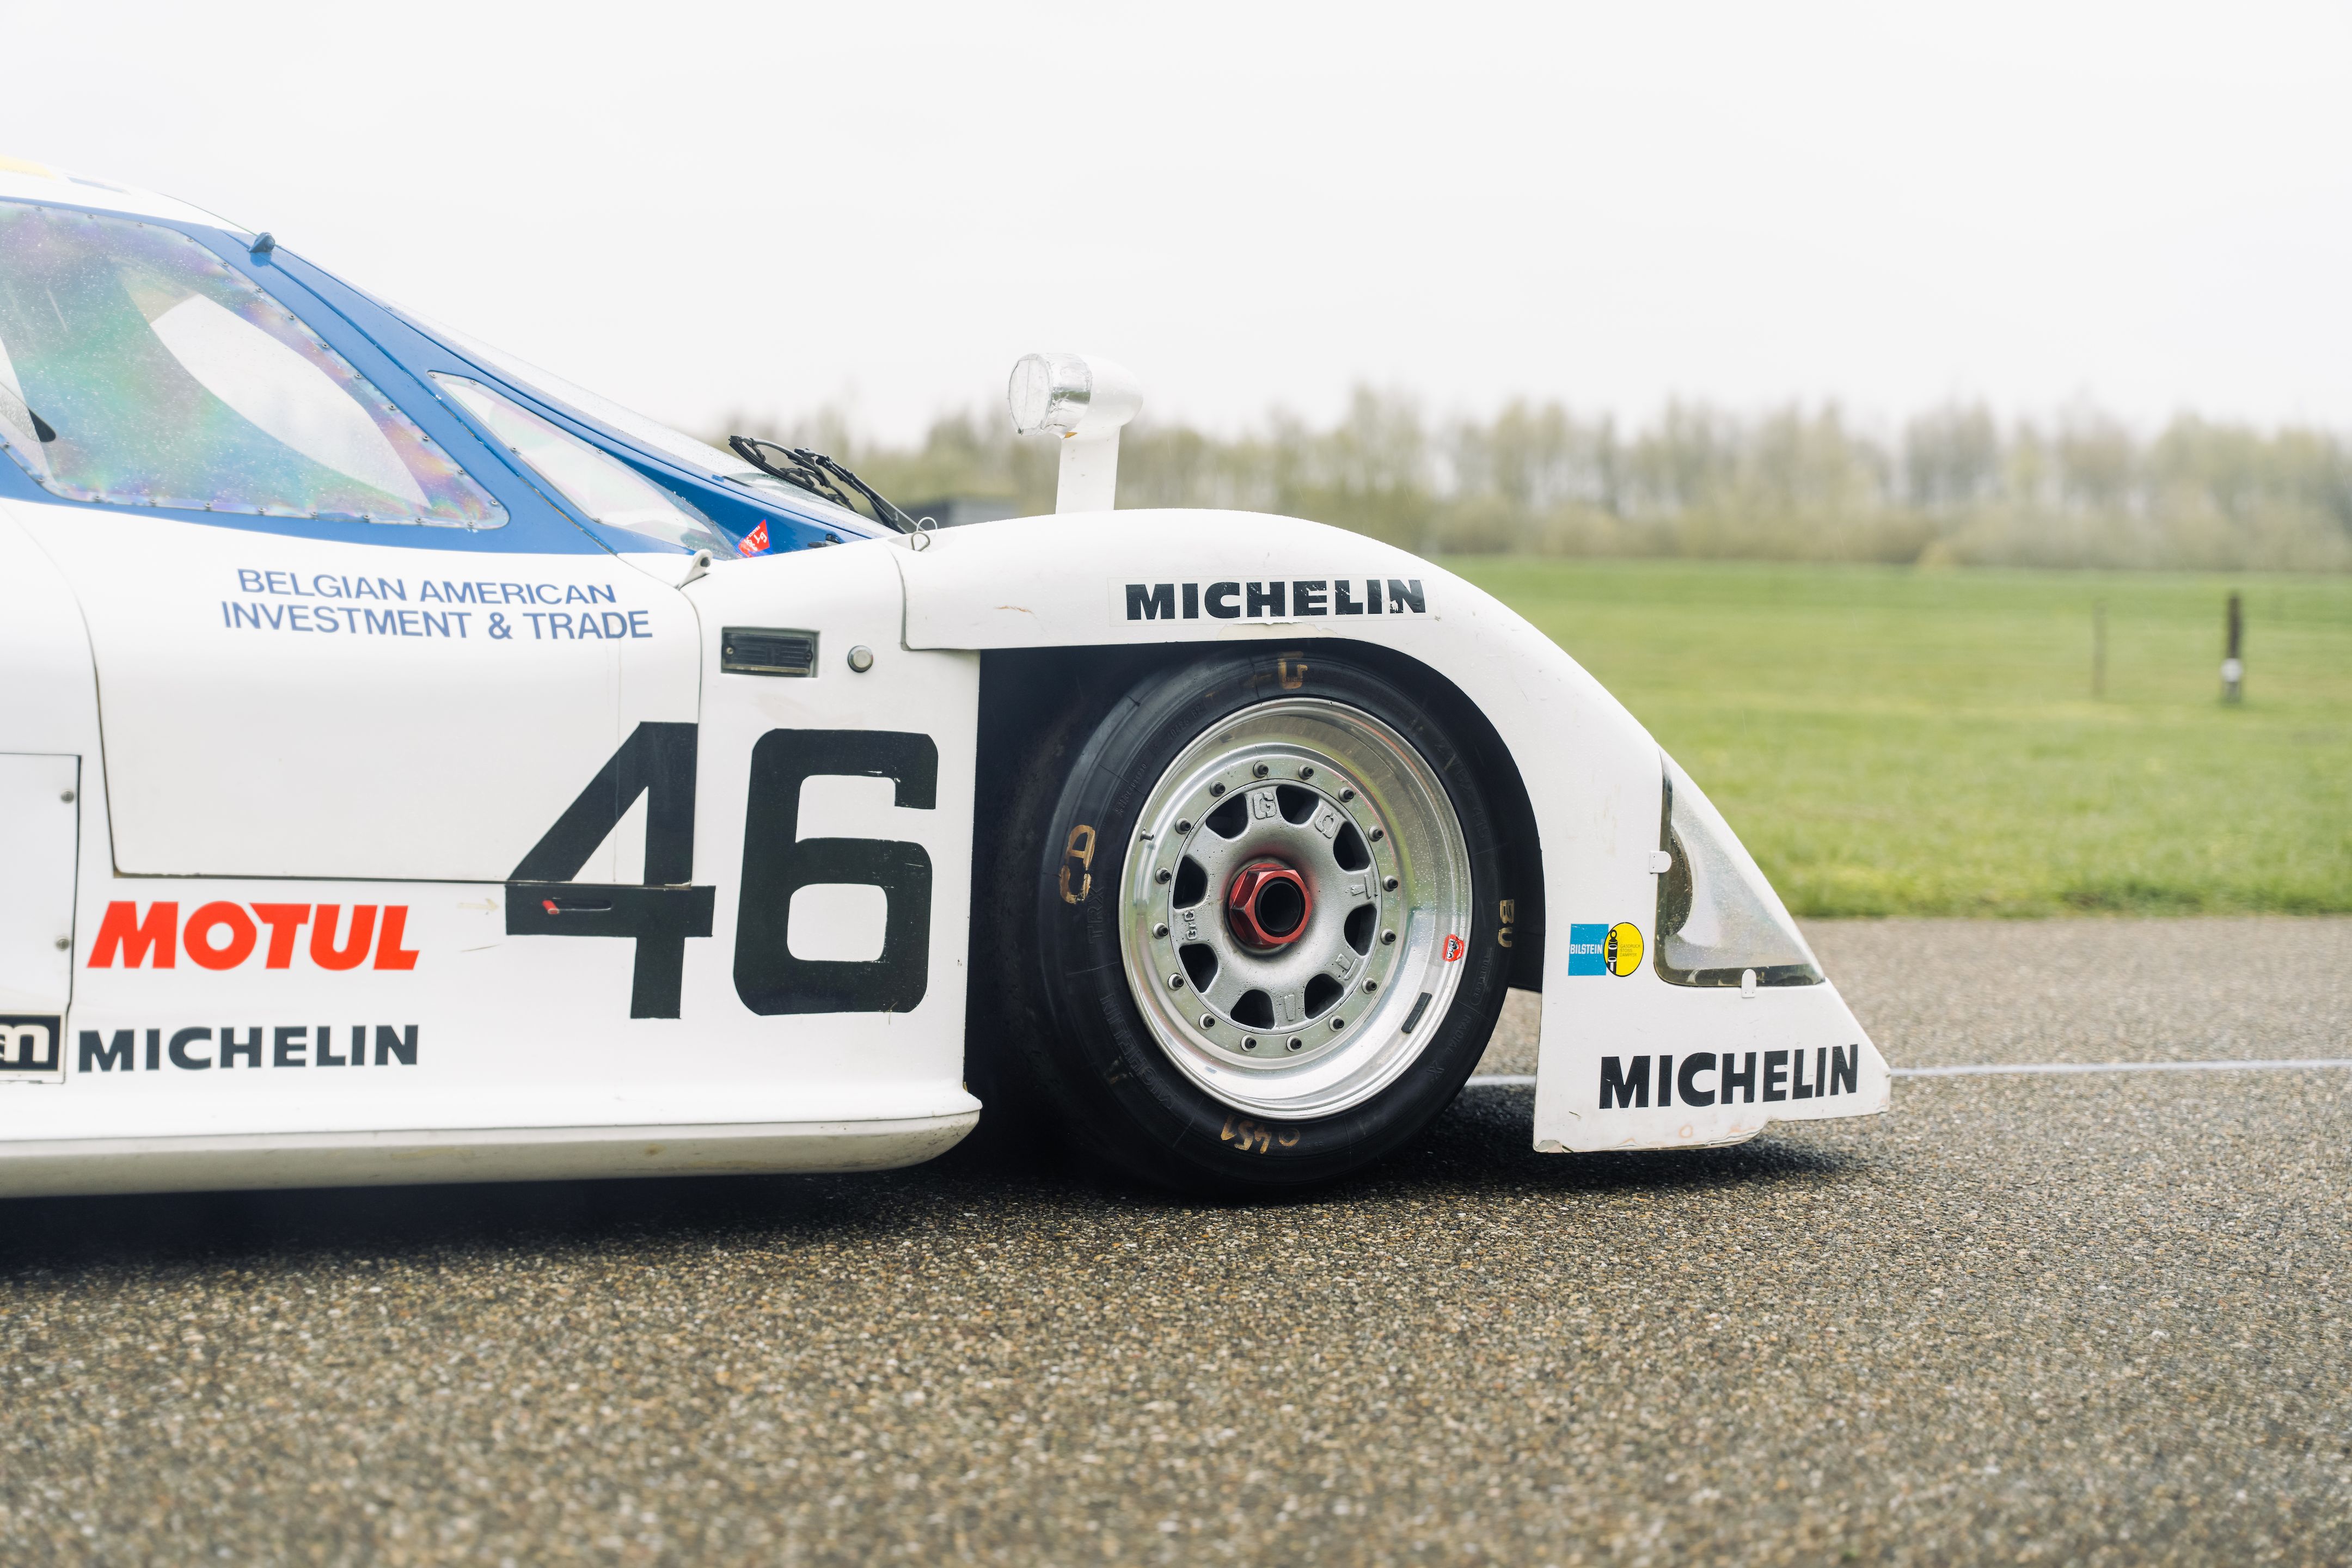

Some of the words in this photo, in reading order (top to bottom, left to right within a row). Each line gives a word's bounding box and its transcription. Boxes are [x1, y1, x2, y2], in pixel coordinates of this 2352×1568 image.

[237, 568, 406, 601] BELGIAN
[420, 580, 616, 604] AMERICAN
[1125, 579, 1426, 620] MICHELIN
[221, 601, 471, 639] INVESTMENT
[488, 612, 513, 640] &
[523, 610, 653, 640] TRADE
[506, 721, 939, 1019] 46
[87, 901, 420, 971] MOTUL
[1570, 944, 1603, 954] BILSTEIN
[78, 1025, 419, 1073] MICHELIN
[1099, 993, 1181, 1110] MICHELIN
[1599, 1044, 1858, 1110] MICHELIN
